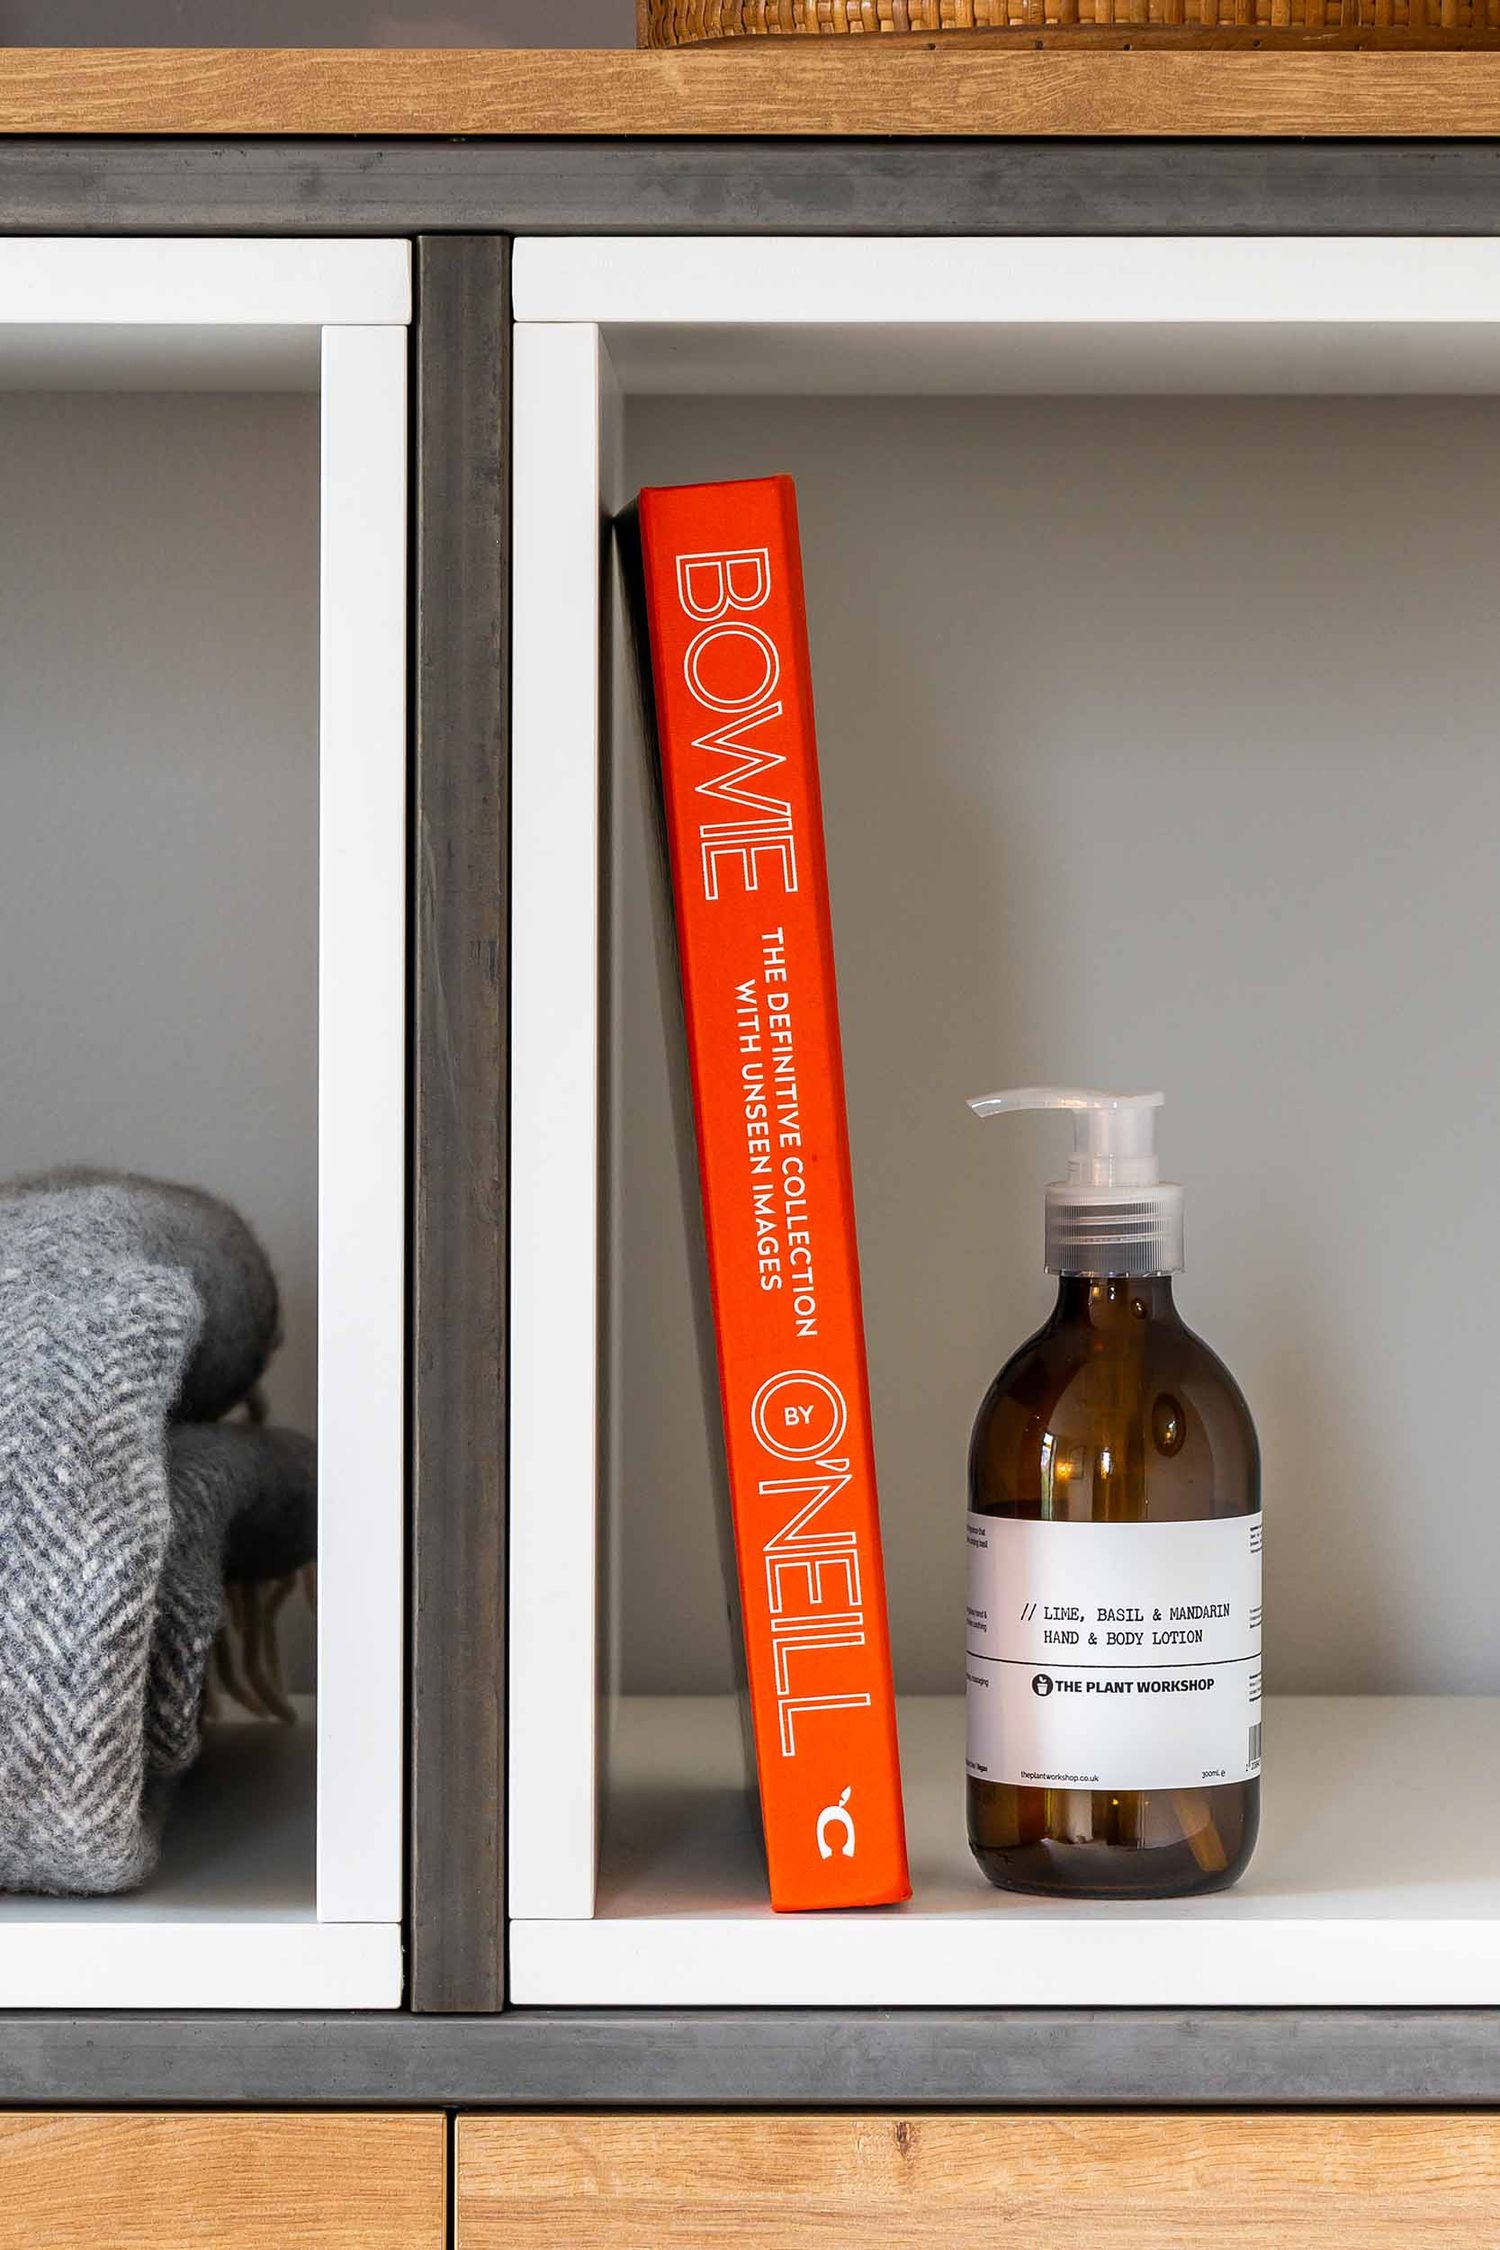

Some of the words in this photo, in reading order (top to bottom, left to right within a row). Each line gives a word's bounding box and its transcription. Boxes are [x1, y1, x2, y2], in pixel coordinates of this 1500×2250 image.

[675, 547, 799, 901] BOWIE
[761, 926, 787, 983] THE
[735, 978, 762, 1053] WITH
[767, 992, 802, 1149] DEFINITIVE
[741, 1062, 772, 1174] UNSEEN
[753, 1184, 783, 1291] IMAGES
[781, 1156, 818, 1337] COLLECTION
[784, 1405, 815, 1426] BY
[751, 1369, 872, 1757] O'NEILL
[1044, 1606, 1085, 1622] LIME,
[1097, 1608, 1144, 1622] BASIL
[1152, 1608, 1162, 1621] &
[1169, 1603, 1231, 1620] MANDARIN
[1044, 1630, 1079, 1644] HAND
[1087, 1633, 1098, 1645] &
[1106, 1631, 1144, 1646] BODY
[1152, 1629, 1203, 1645] LOTION
[1055, 1680, 1083, 1692] THE
[1086, 1681, 1133, 1693] PLANT
[1136, 1678, 1215, 1693] WORKSHOP
[1020, 1770, 1100, 1783] theplantworkshop.co.uk
